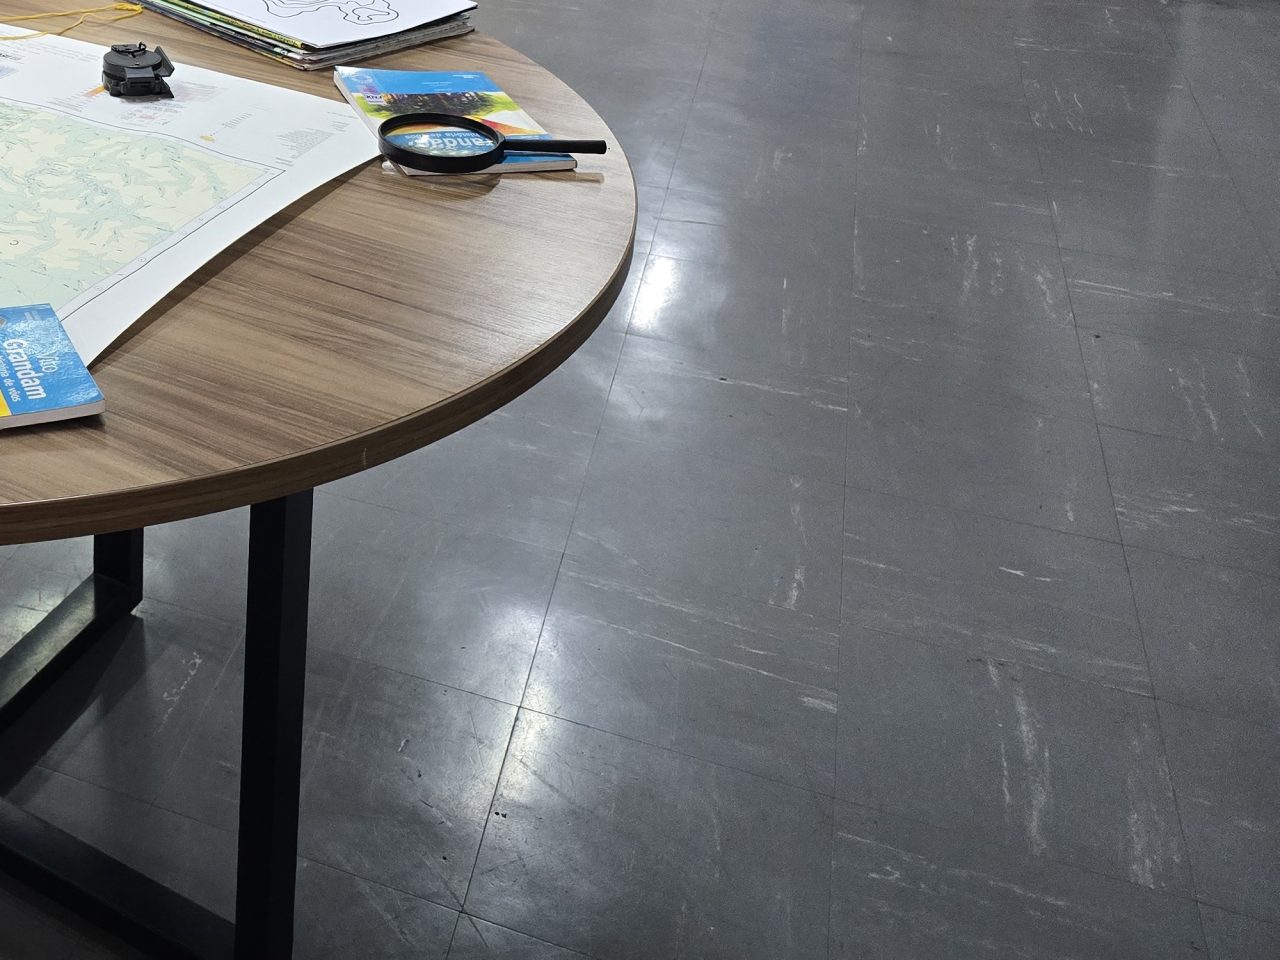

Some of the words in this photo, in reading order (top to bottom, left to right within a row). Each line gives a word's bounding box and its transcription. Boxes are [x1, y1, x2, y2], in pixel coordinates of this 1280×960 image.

[2, 339, 47, 400] Grandam
[36, 350, 59, 373] Vito
[3, 378, 15, 387] de
